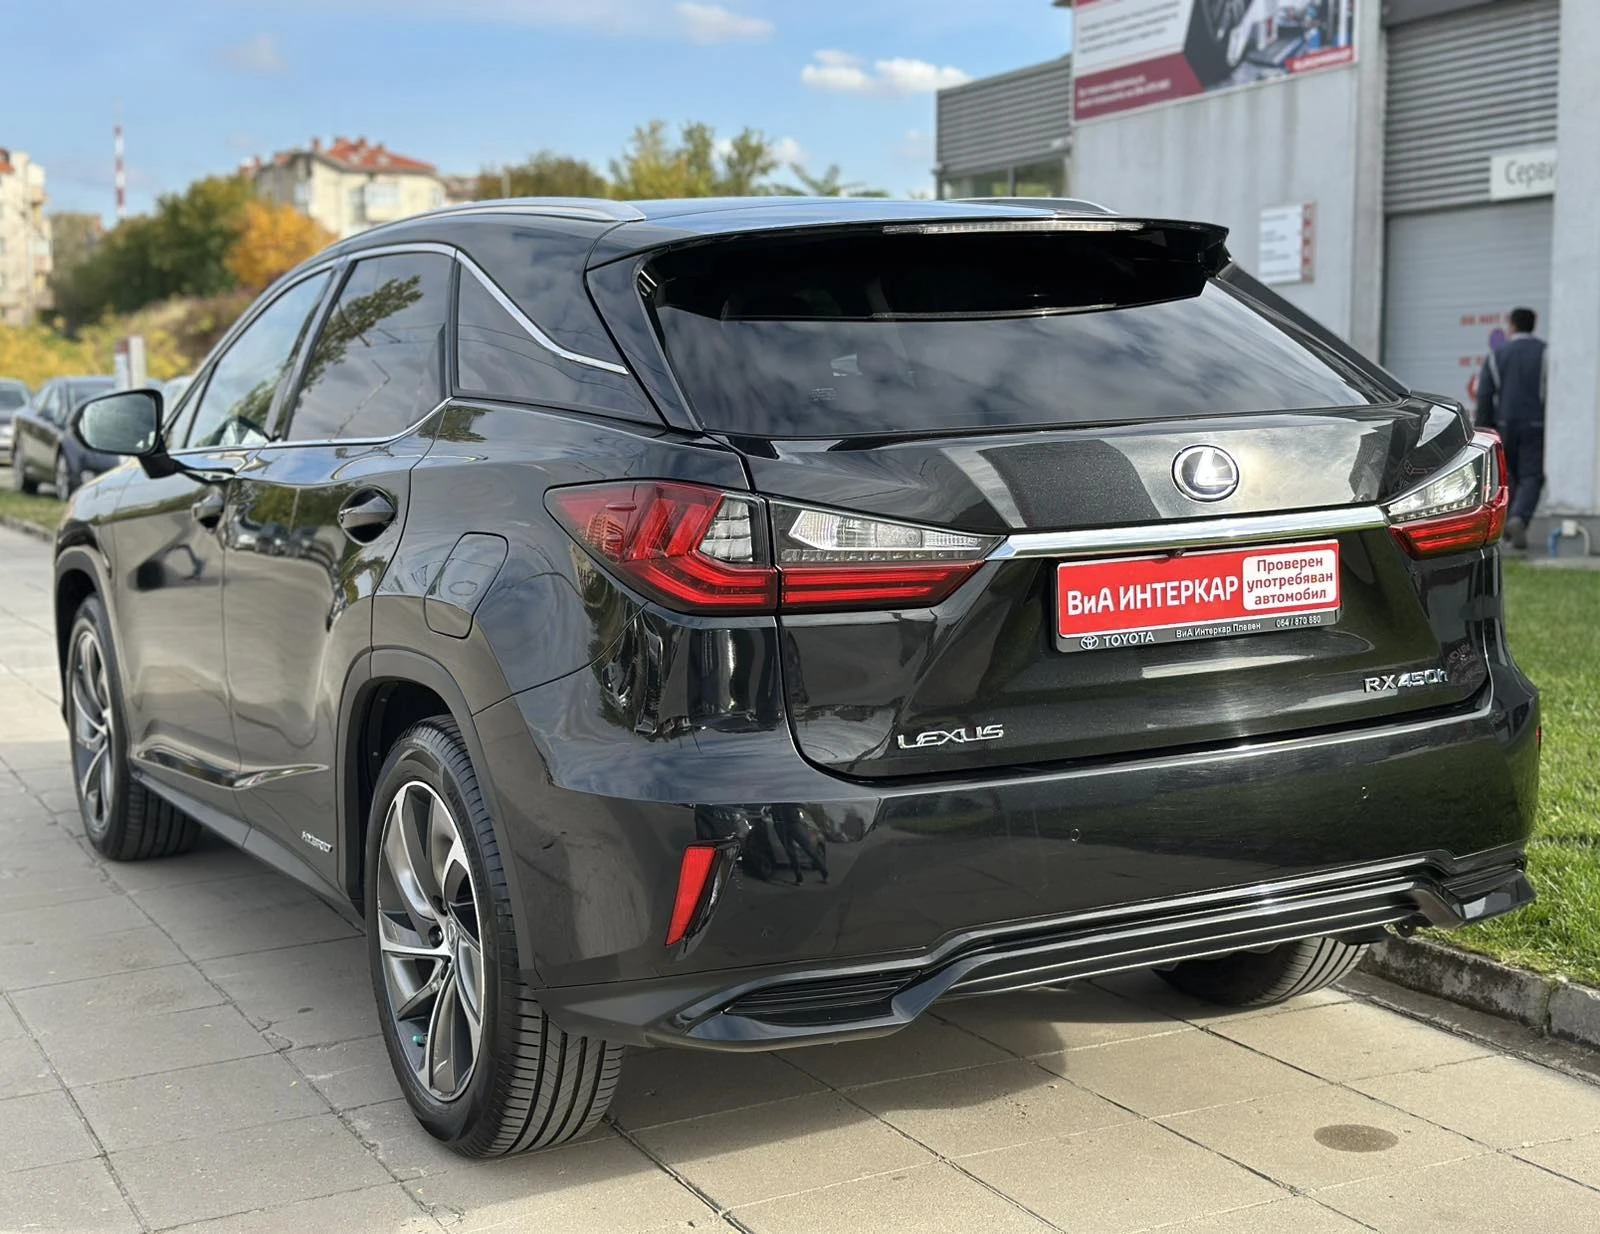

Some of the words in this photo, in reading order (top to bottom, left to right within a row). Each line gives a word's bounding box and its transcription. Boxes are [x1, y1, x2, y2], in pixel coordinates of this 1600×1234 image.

[1257, 557, 1323, 574] Проверен
[1247, 572, 1333, 593] употребяван
[1067, 587, 1115, 615] ВиА
[1119, 575, 1239, 611] ИНТЕРКАР
[1254, 587, 1327, 605] автомобил
[1103, 631, 1155, 647] TOYOTA
[1176, 628, 1194, 638] ВиА
[897, 723, 1004, 749] LEXUS
